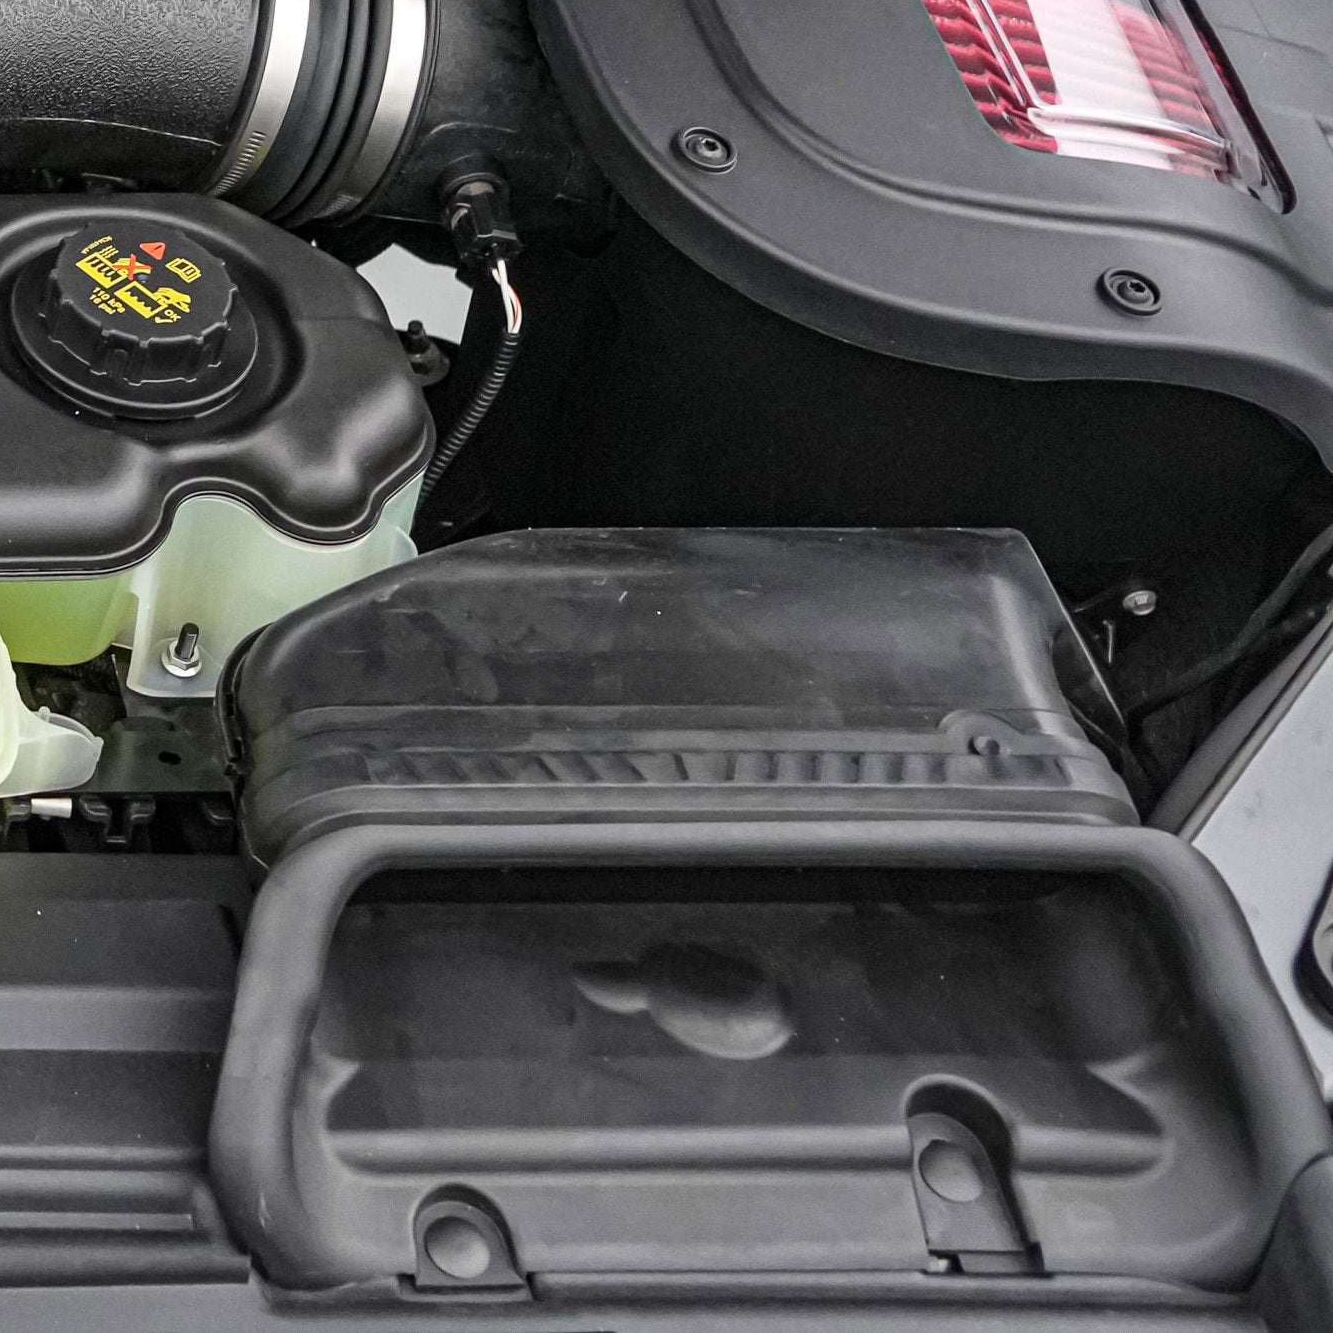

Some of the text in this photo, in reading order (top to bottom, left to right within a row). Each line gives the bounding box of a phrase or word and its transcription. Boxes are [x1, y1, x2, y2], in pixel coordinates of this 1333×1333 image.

[89, 293, 116, 316] 16 psi
[92, 286, 126, 314] 110 kPa
[164, 308, 181, 323] OK
